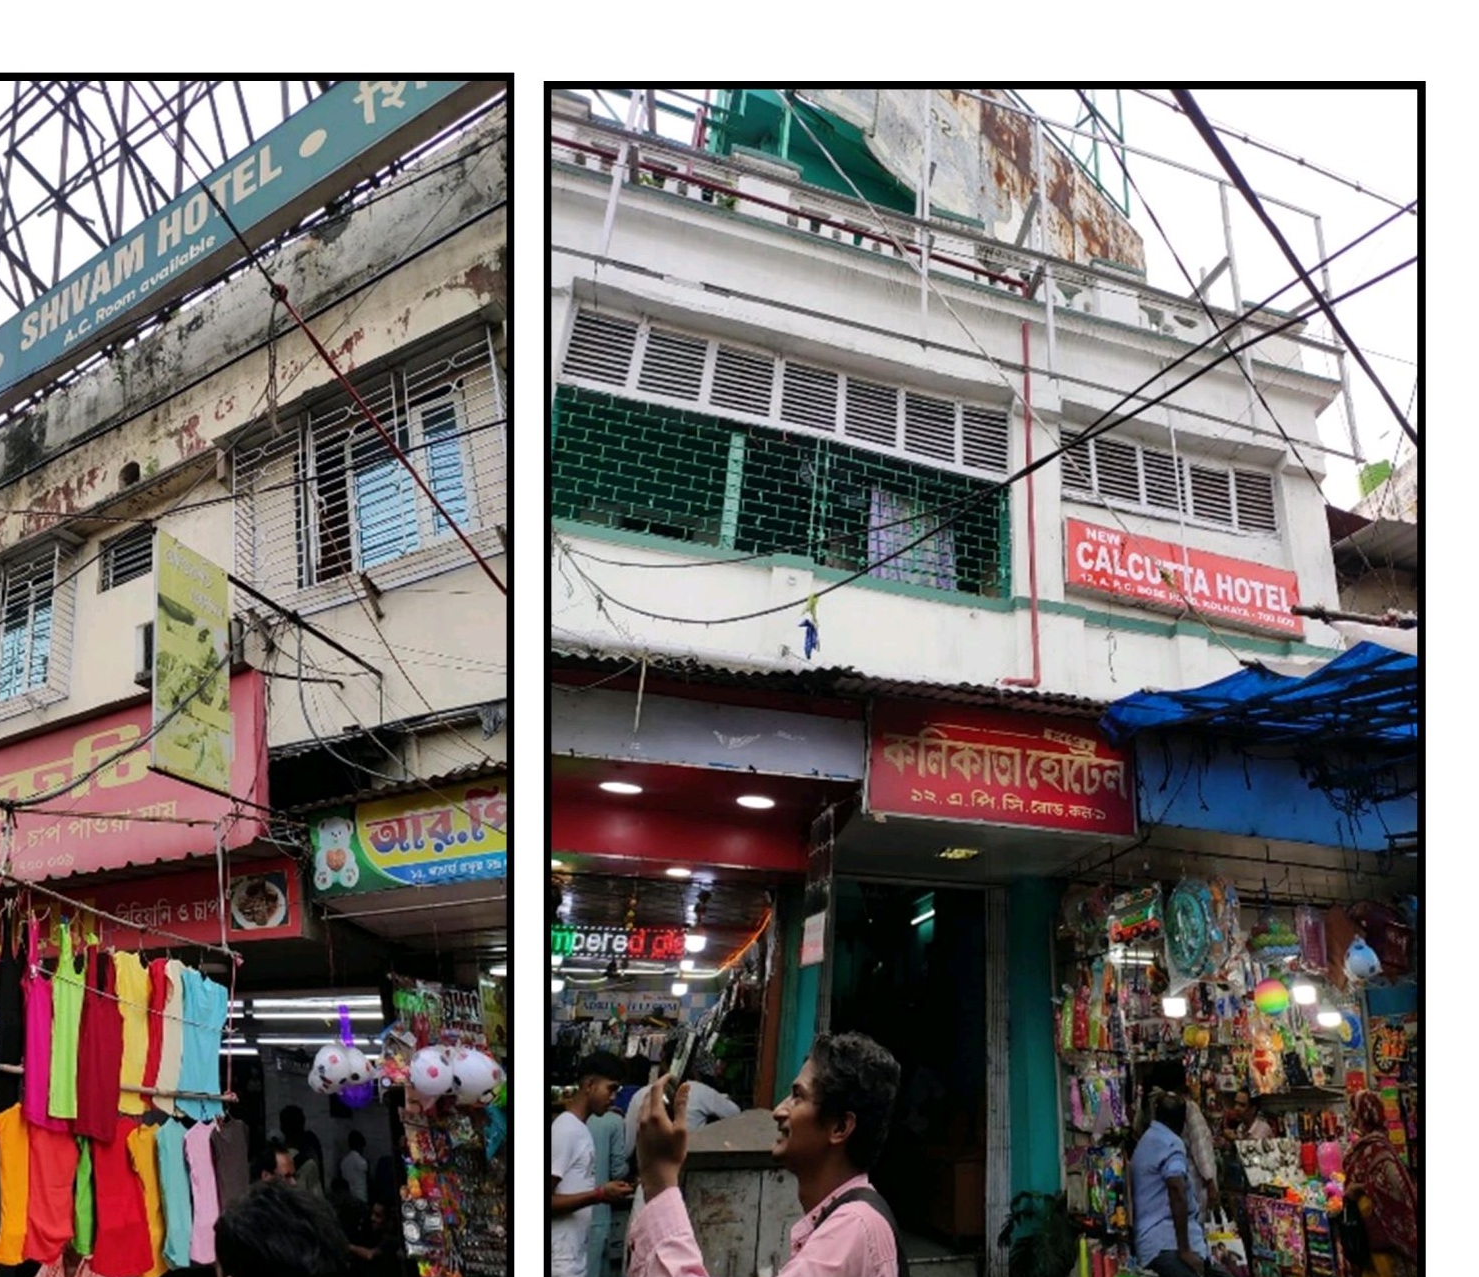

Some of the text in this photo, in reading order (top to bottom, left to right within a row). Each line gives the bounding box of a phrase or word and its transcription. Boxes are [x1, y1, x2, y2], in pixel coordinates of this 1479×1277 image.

[21, 145, 282, 351] SHIVAM HOTEL
[64, 234, 216, 346] A.C. Room available
[1086, 527, 1120, 544] NEW
[1076, 541, 1293, 613] CALCUTTA HOTEL
[883, 726, 1127, 799] কলিকাতা হোটেল
[27, 826, 61, 849] চাপ
